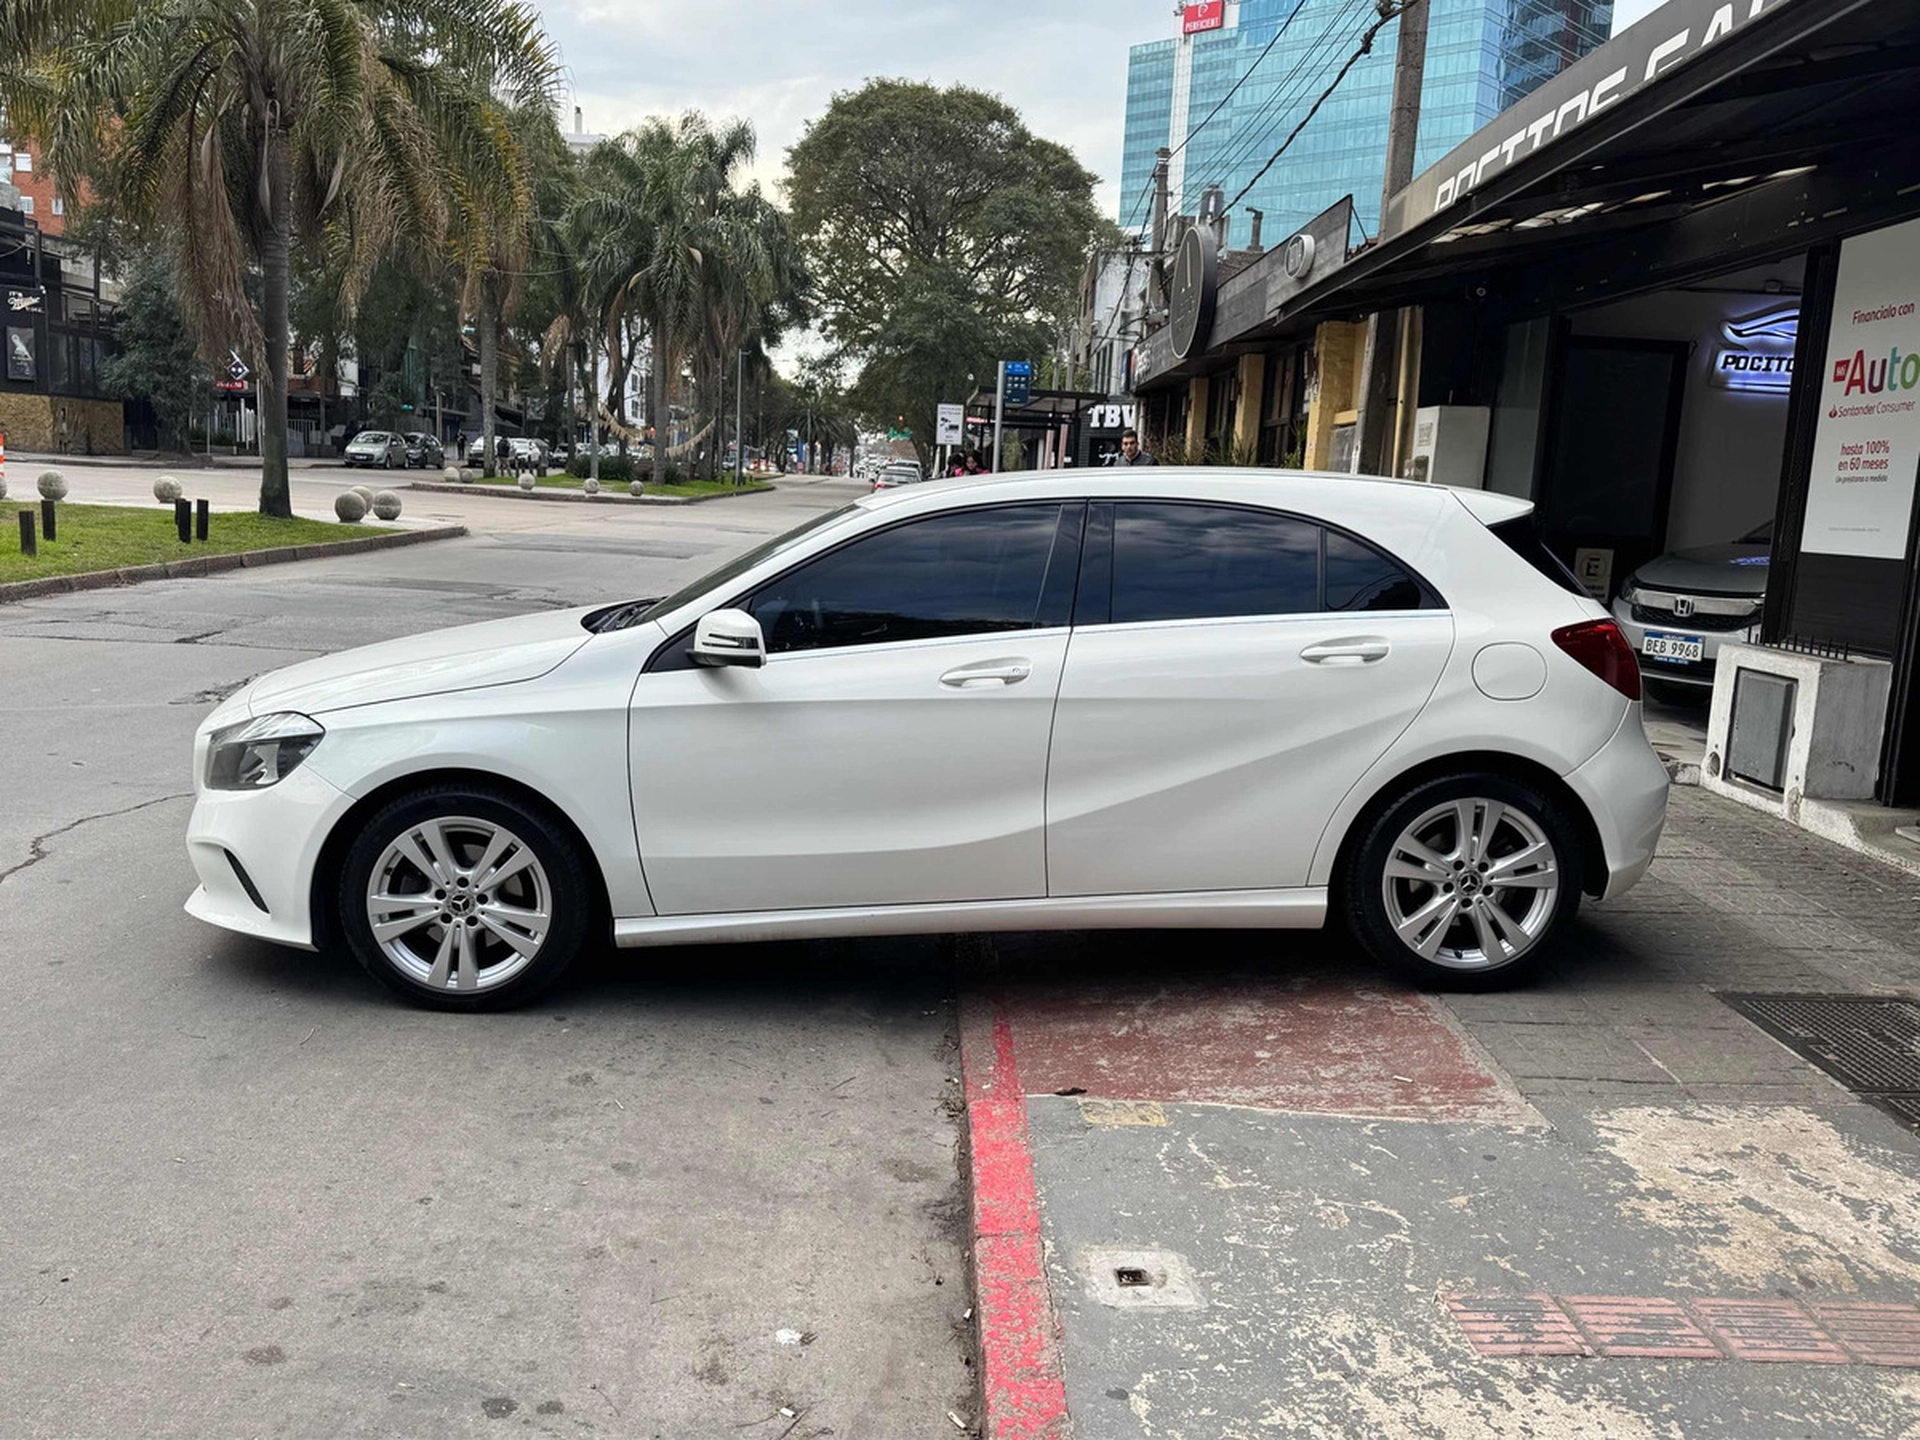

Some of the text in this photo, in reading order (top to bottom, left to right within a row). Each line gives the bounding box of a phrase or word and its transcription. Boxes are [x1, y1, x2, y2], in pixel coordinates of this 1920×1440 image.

[1898, 303, 1915, 316] con
[1844, 346, 1920, 396] Auto
[1838, 401, 1916, 418] Santander Consumer
[1840, 440, 1890, 455] hasta 100%
[1838, 457, 1889, 472] en 60 meses
[1645, 639, 1699, 658] BEB 9968
